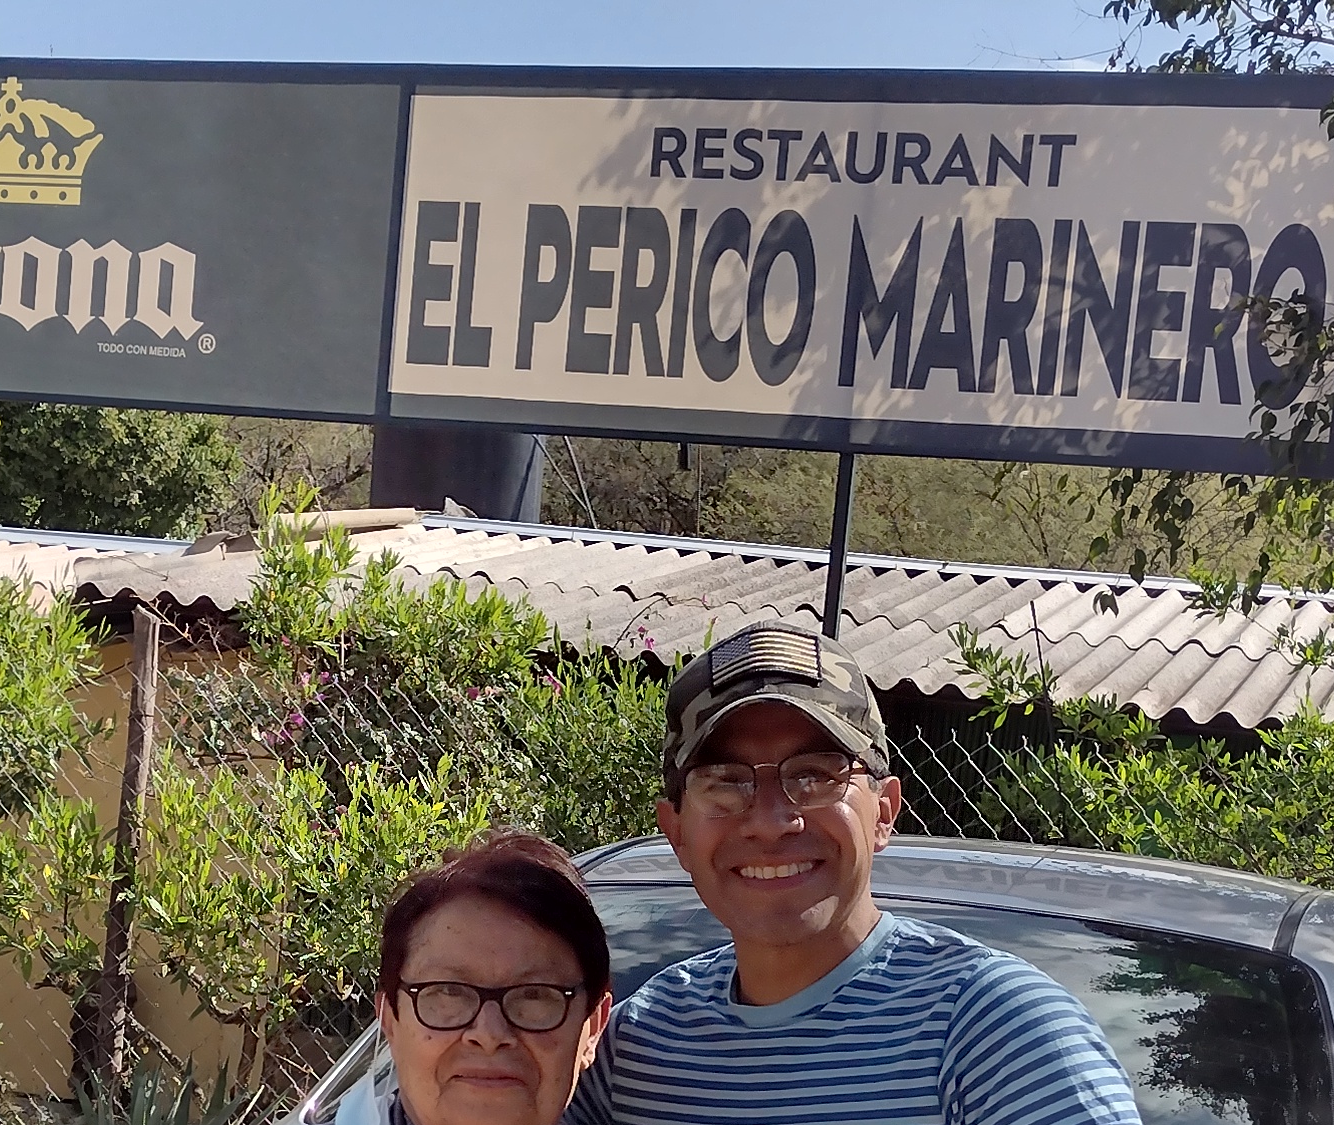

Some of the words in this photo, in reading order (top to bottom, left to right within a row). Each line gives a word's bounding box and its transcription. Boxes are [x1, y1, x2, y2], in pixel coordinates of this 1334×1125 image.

[650, 127, 1077, 188] RESTAURANT
[406, 200, 492, 368] EL
[515, 203, 816, 388] PERICO
[838, 214, 1327, 411] MARINERO
[97, 342, 124, 354] TODO
[126, 344, 147, 356] CON
[149, 345, 186, 358] MEDIDA
